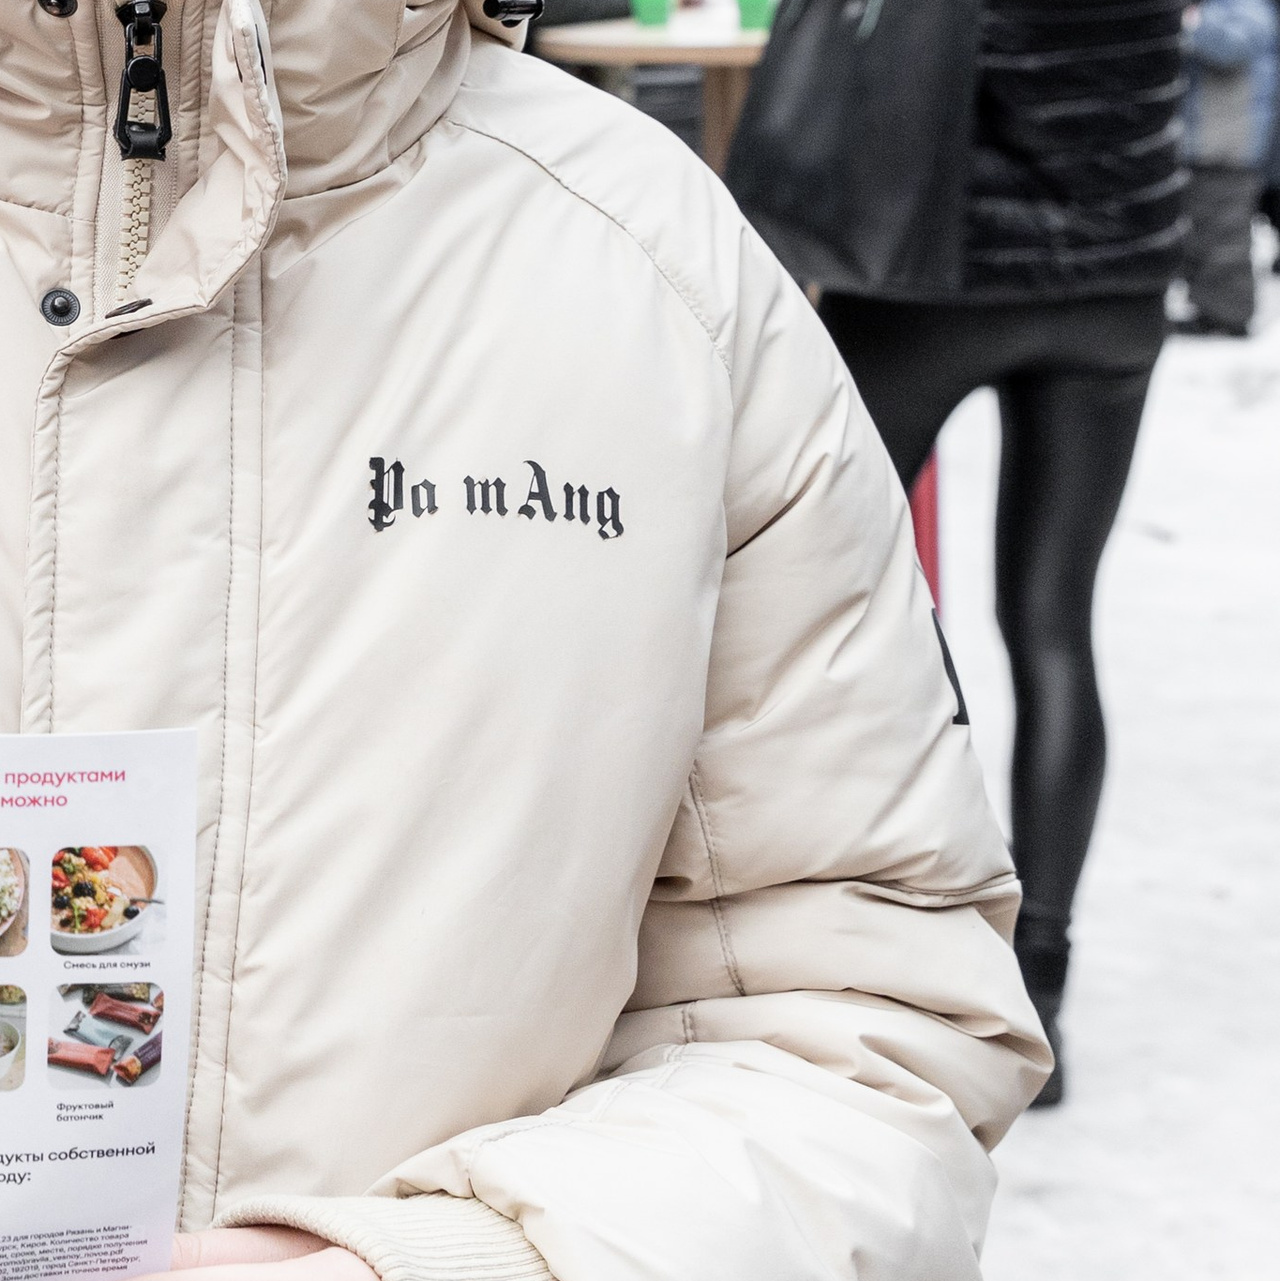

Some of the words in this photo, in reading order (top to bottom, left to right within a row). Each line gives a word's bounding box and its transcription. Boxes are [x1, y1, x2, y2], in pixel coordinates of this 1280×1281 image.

[4, 769, 126, 788] продуктами
[0, 794, 68, 808] можно
[63, 960, 97, 970] Смесь
[99, 961, 118, 969] для
[56, 1100, 115, 1112] Фруктовый
[56, 1113, 104, 1122] батончик
[48, 1141, 156, 1162] собственной
